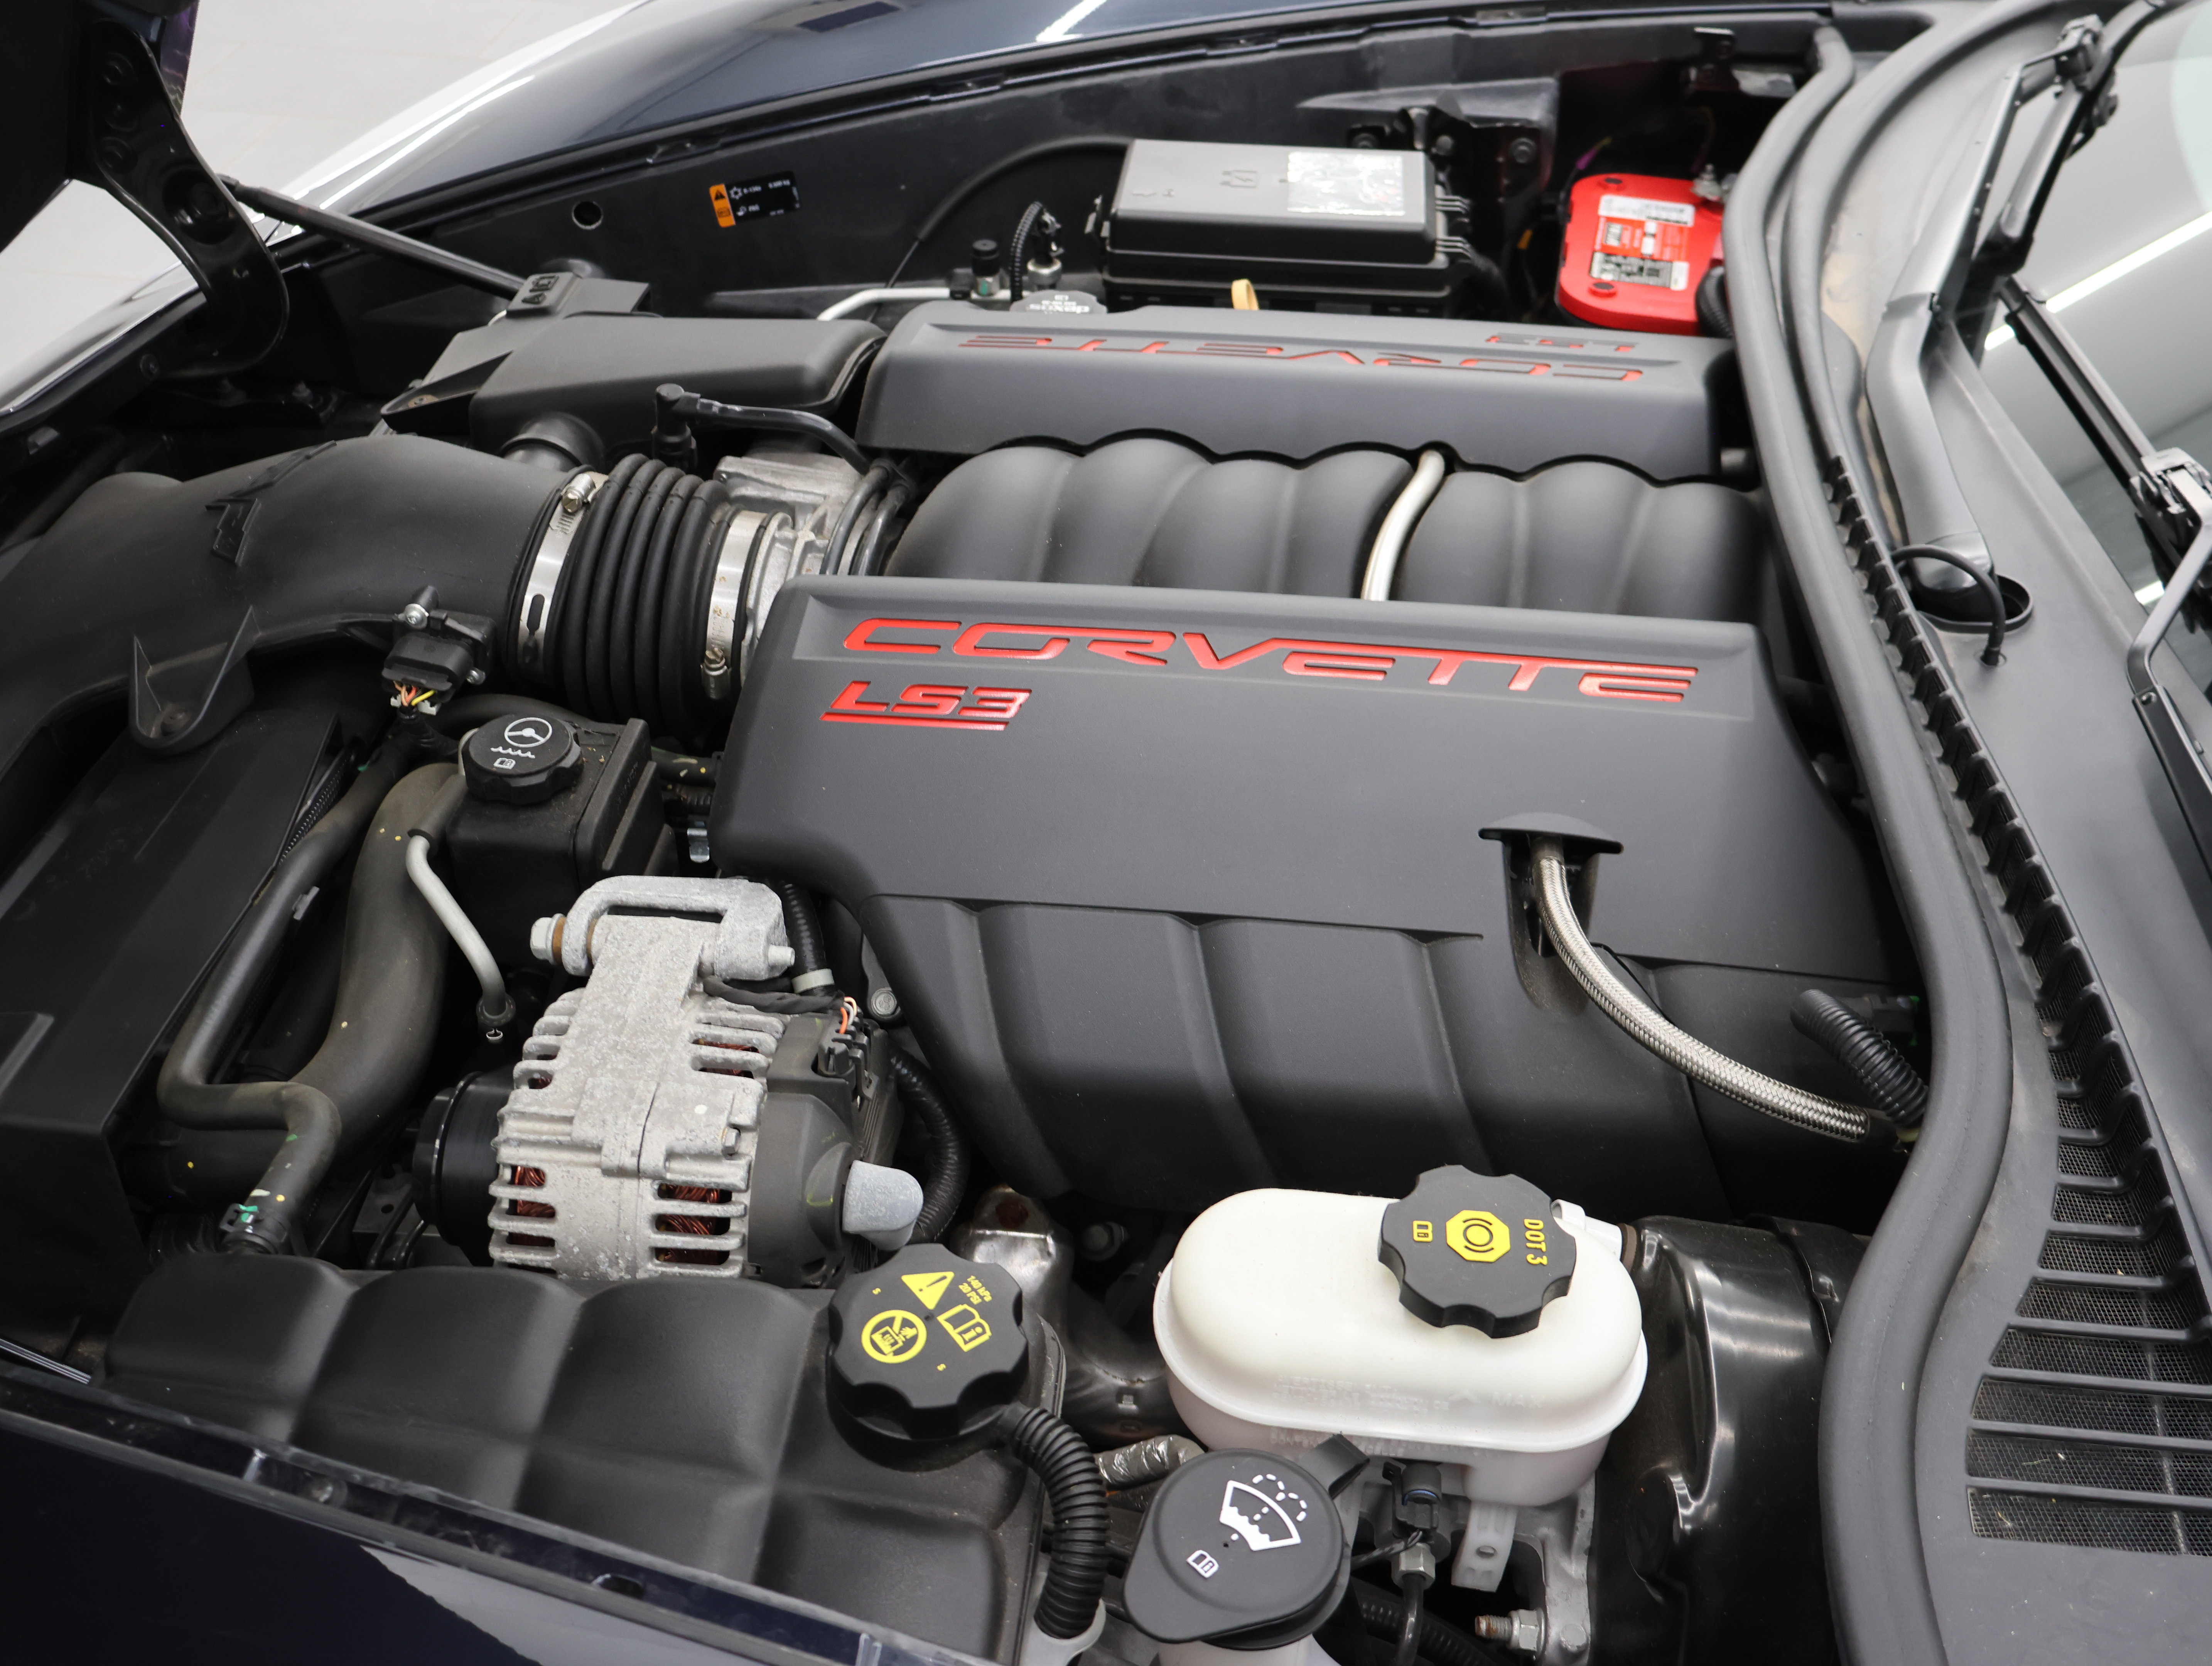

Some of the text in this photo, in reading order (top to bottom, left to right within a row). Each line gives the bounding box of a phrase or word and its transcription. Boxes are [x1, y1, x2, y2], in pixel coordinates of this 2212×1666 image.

[844, 618, 1699, 703] CORVETTE
[829, 680, 1033, 718] LS3
[1523, 1219, 1549, 1266] DOT 3
[958, 1283, 982, 1305] 20 PSI
[967, 1275, 992, 1302] 140 kPa
[1492, 1391, 1546, 1409] MAX
